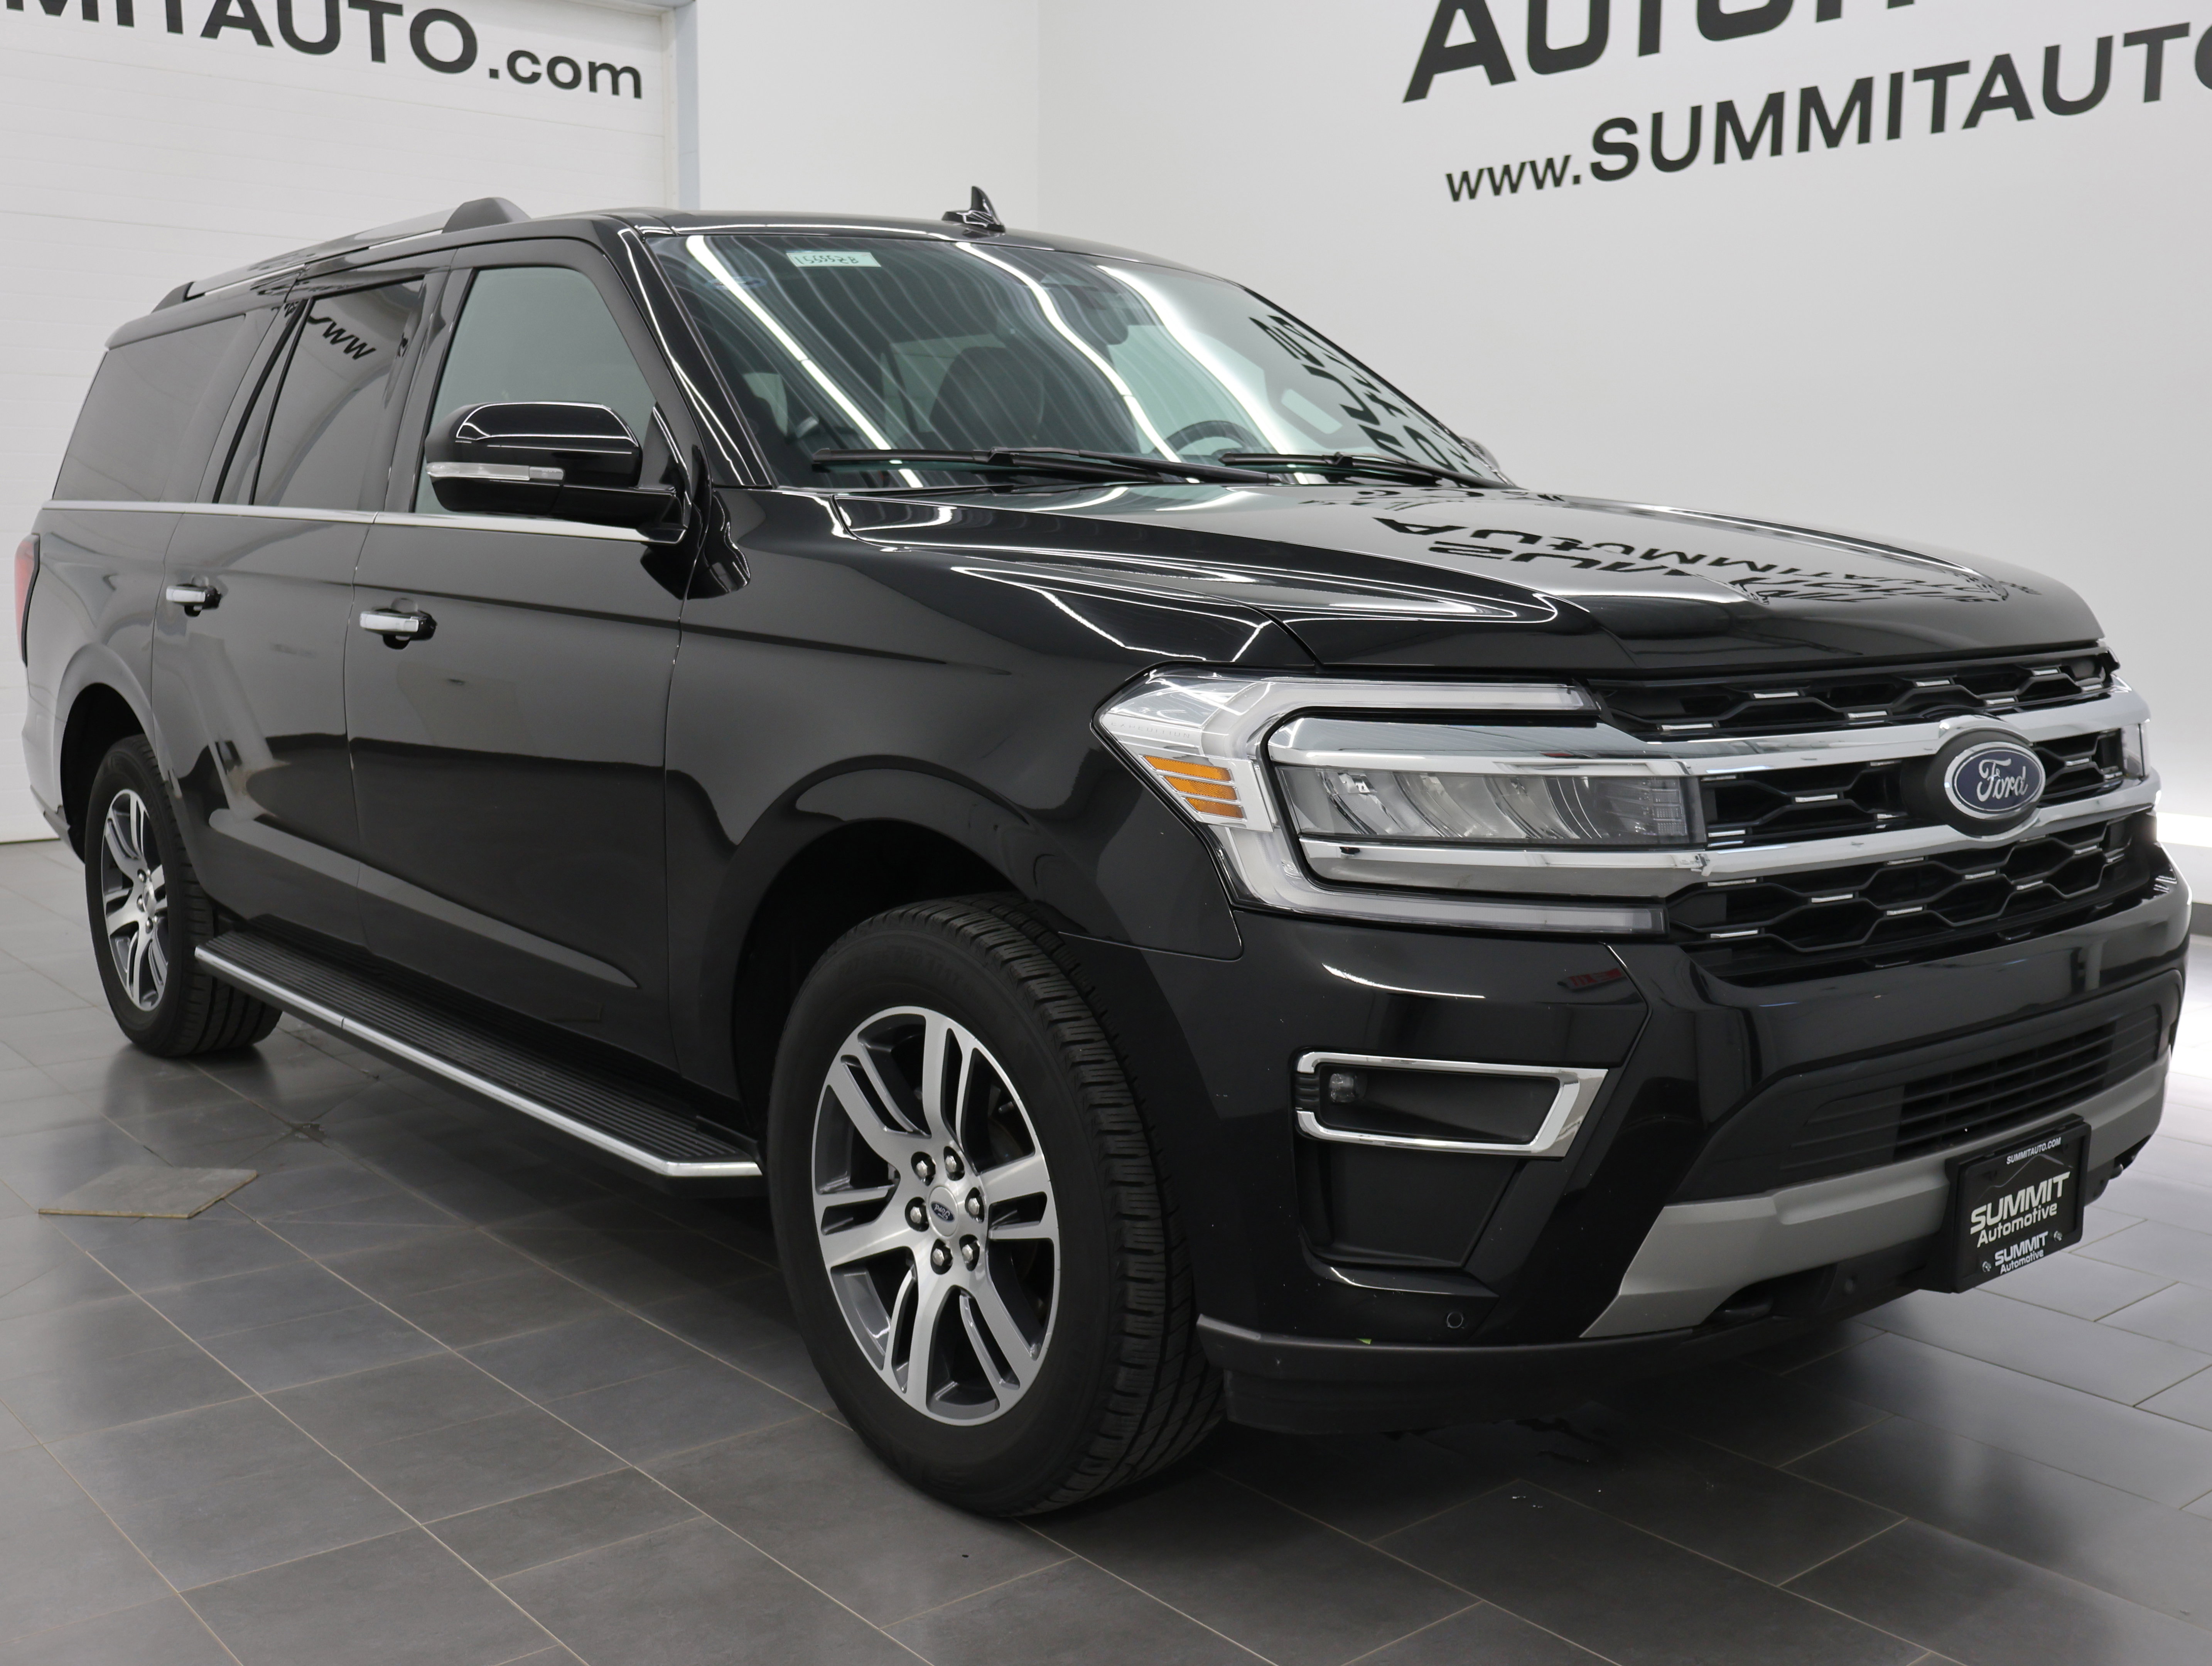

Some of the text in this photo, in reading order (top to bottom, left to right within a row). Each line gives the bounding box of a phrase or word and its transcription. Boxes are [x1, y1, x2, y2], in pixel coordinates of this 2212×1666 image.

[1446, 22, 2212, 202] www.SUMMITAUT
[1976, 758, 2028, 802] Ford
[2006, 1137, 2062, 1165] SUMMITAUTO.COM
[1970, 1171, 2071, 1235] SUMMIT
[1977, 1202, 2058, 1248] Automotive
[1994, 1231, 2048, 1266] SUMMIT
[2000, 1249, 2044, 1275] Automotive
